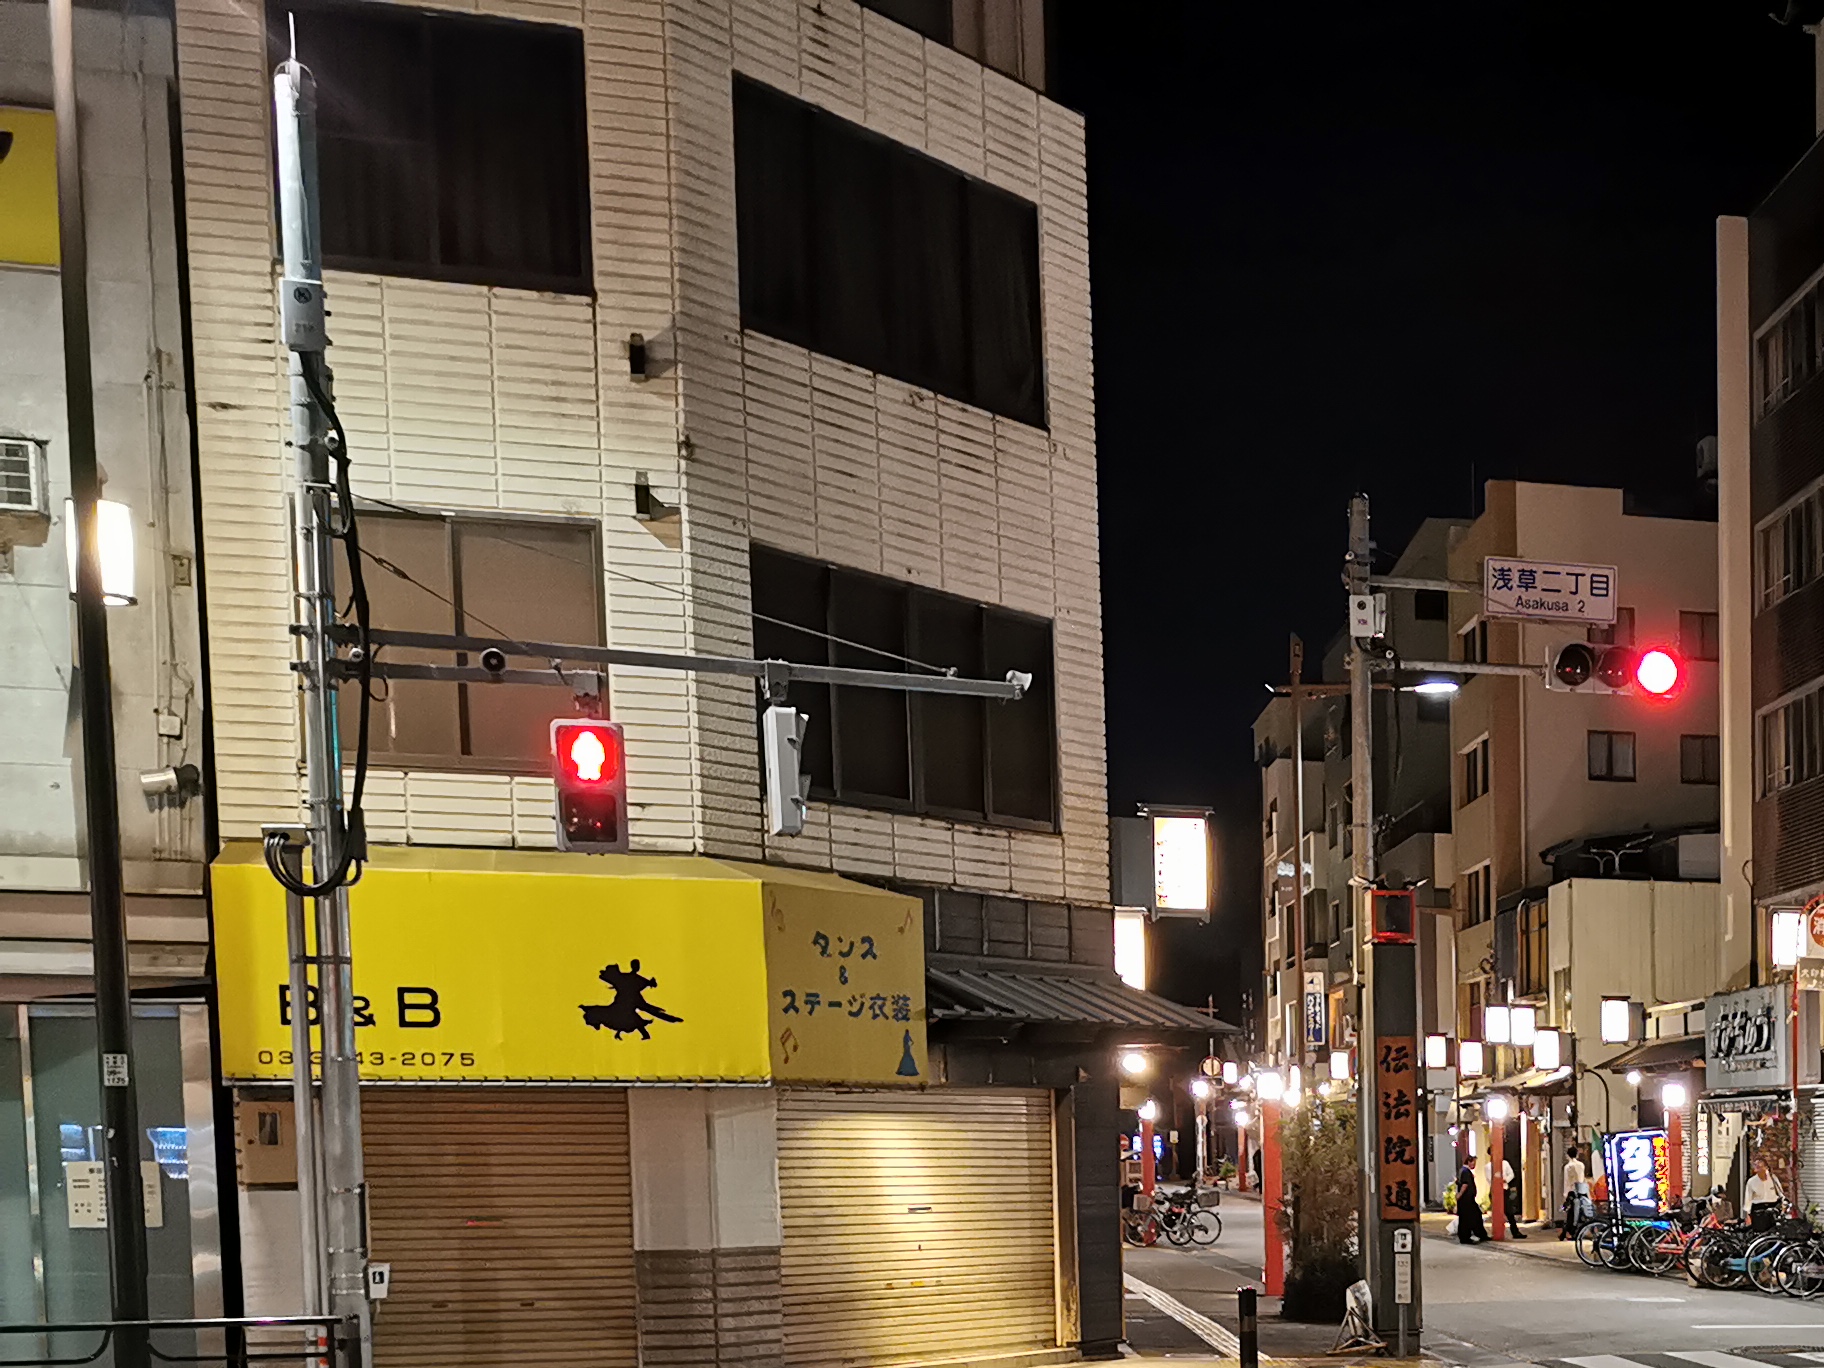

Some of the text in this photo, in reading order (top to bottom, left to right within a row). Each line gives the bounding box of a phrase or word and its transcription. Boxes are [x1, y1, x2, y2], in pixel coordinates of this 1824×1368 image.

[1492, 567, 1609, 597] 浅草二丁目
[1515, 595, 1585, 613] Asakusa 2
[397, 986, 441, 1028] B
[782, 989, 911, 1022] ステージ衣装
[1380, 1044, 1415, 1211] 伝法院通
